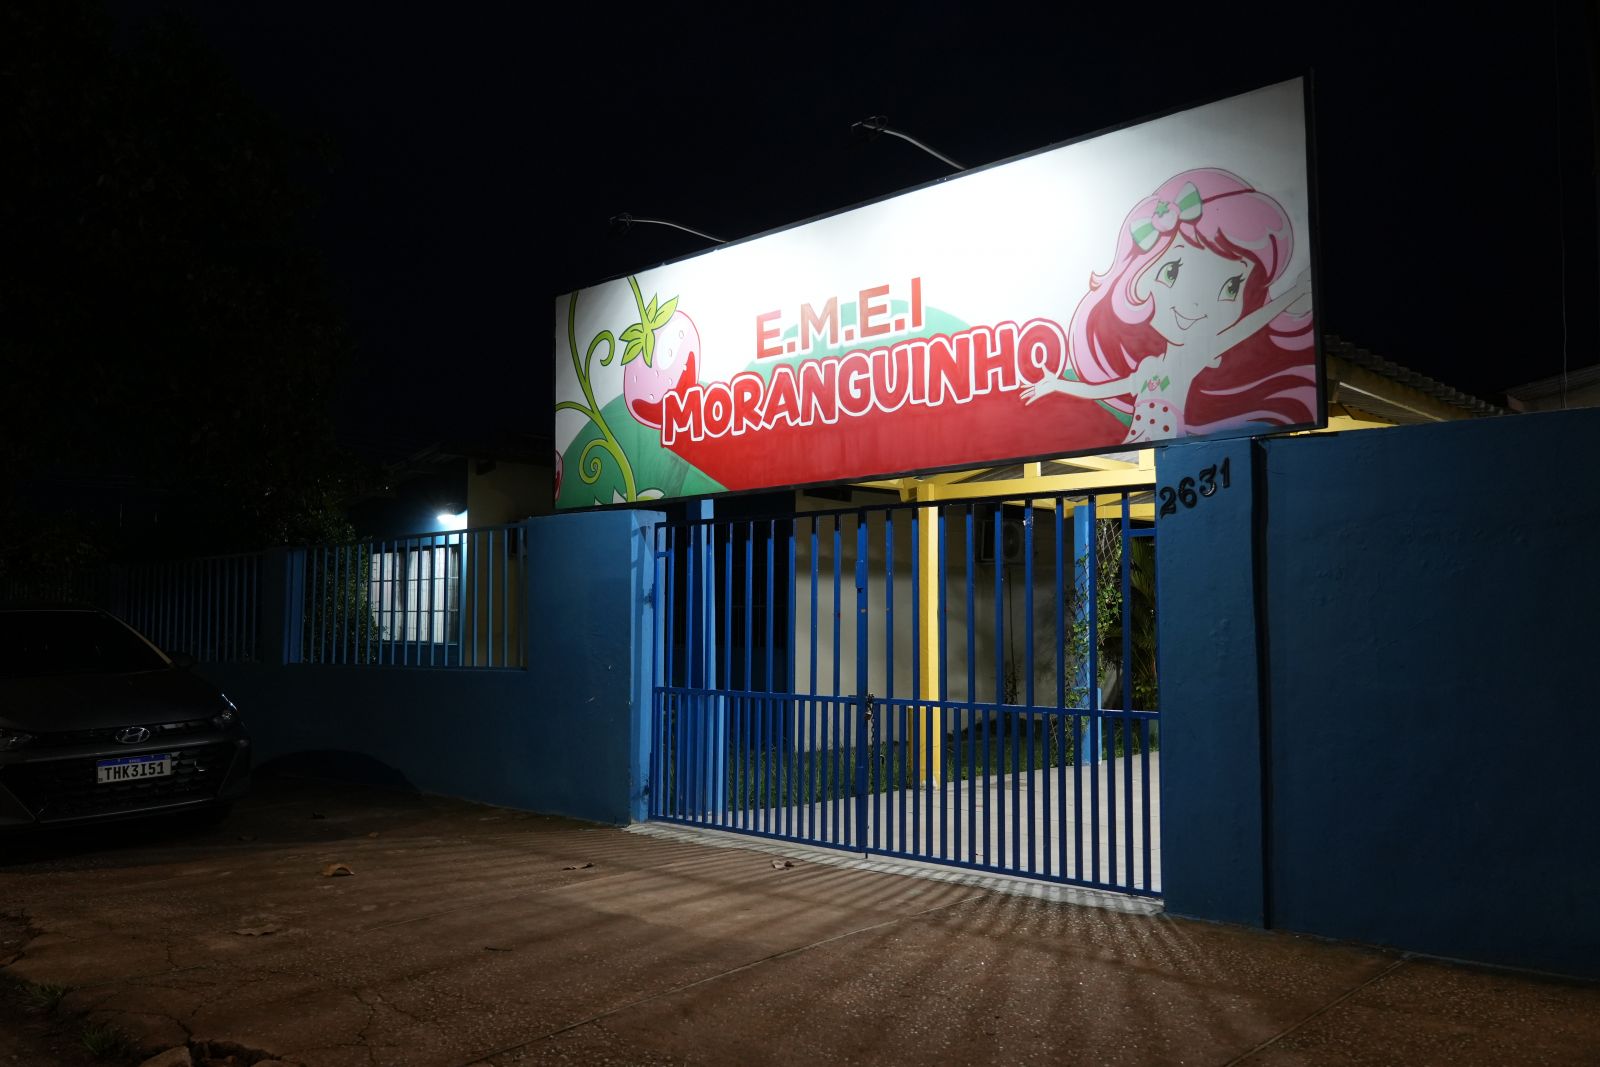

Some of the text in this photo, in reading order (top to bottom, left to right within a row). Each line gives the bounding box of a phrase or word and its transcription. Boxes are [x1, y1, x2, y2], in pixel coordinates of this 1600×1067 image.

[756, 277, 922, 359] E.M.E.I
[661, 317, 1068, 446] MORANGUINHO
[1160, 457, 1230, 519] 2631
